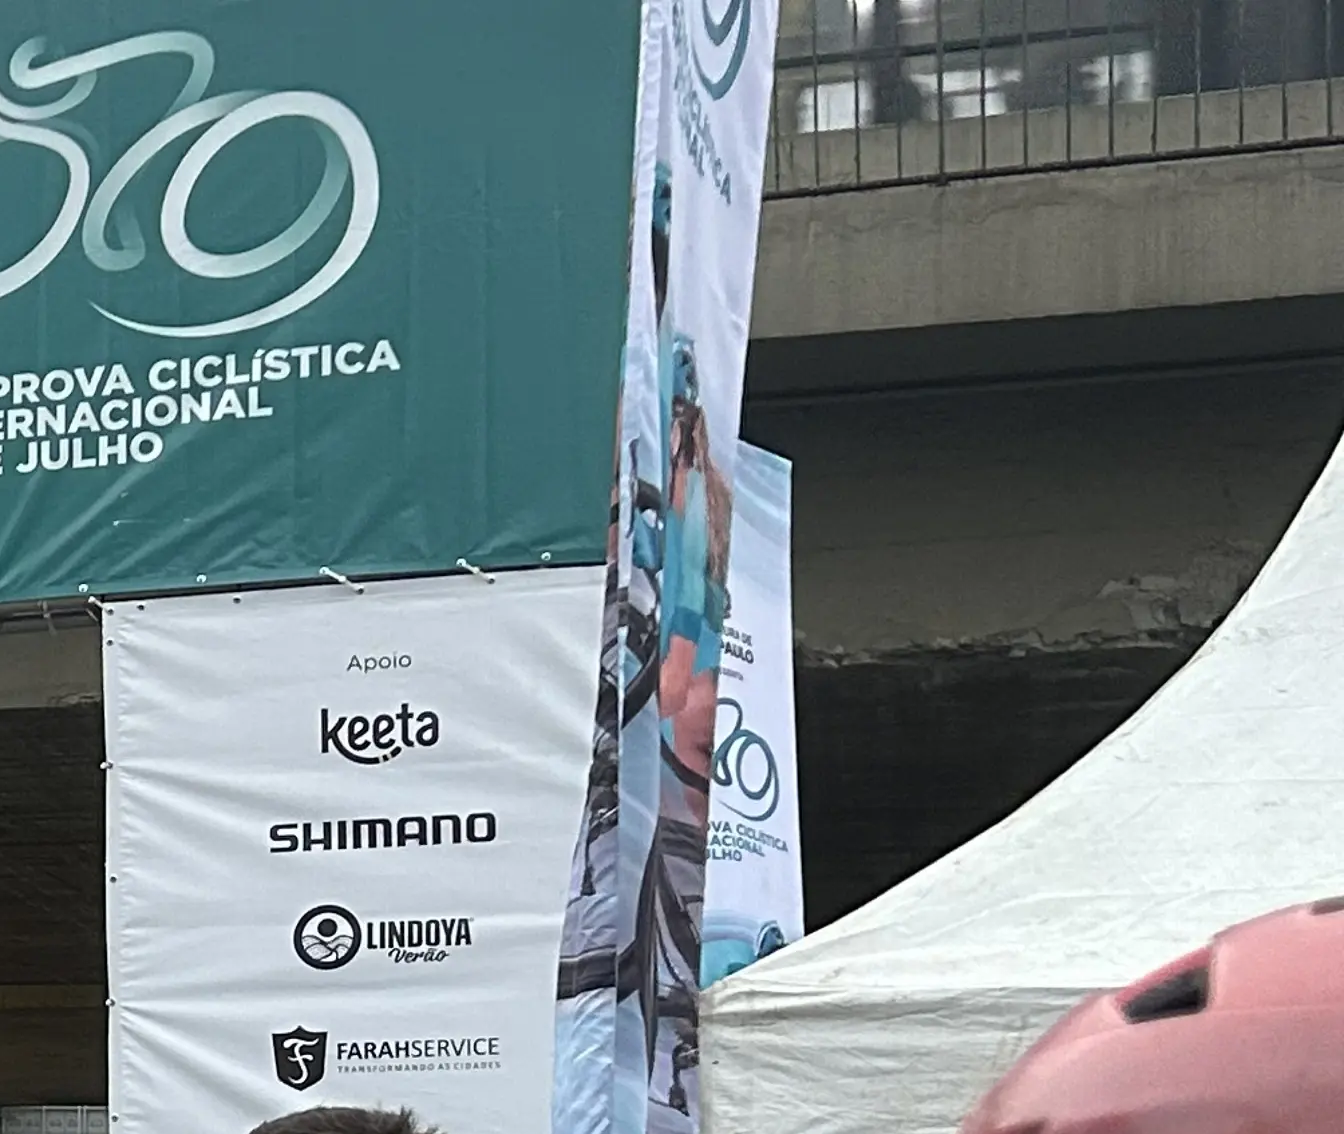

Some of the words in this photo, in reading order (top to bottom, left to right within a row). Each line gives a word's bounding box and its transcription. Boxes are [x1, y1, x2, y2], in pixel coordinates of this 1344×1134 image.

[148, 339, 400, 391] CICLÍSTICA
[16, 431, 164, 475] JULHO
[347, 651, 412, 674] Apoio
[320, 703, 440, 766] keeta
[269, 811, 496, 854] SHIMANO
[366, 917, 473, 950] LINDOYA
[387, 946, 450, 965] Verão
[337, 1037, 500, 1060] FARAHSERVICE
